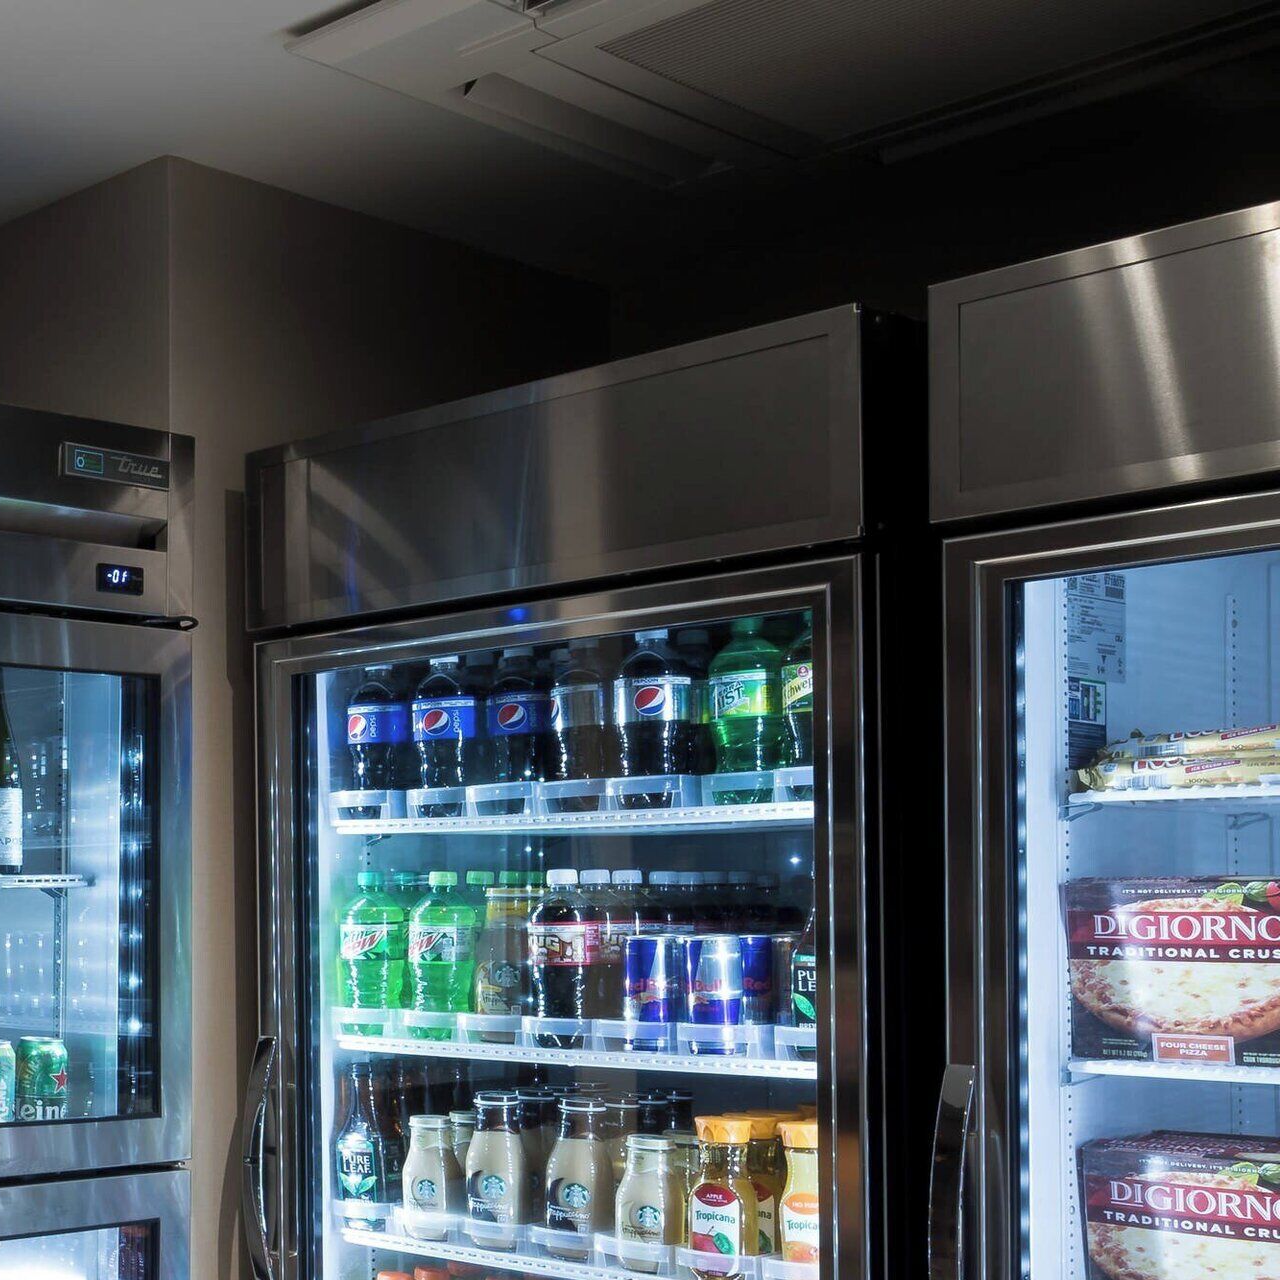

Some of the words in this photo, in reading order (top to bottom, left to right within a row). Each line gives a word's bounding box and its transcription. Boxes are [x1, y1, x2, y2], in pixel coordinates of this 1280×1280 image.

[1086, 946, 1220, 959] TRADITIONAL
[1228, 946, 1280, 960] CRUS
[1160, 1041, 1186, 1050] FOUR
[1189, 1042, 1227, 1052] CHEESE
[1179, 1048, 1209, 1058] PIZZA
[342, 1154, 371, 1166] PURE
[706, 1192, 724, 1201] APPLE
[695, 1209, 736, 1224] Tropicana
[1103, 1210, 1236, 1237] TRADITIONAL
[1244, 1226, 1280, 1240] CRU
